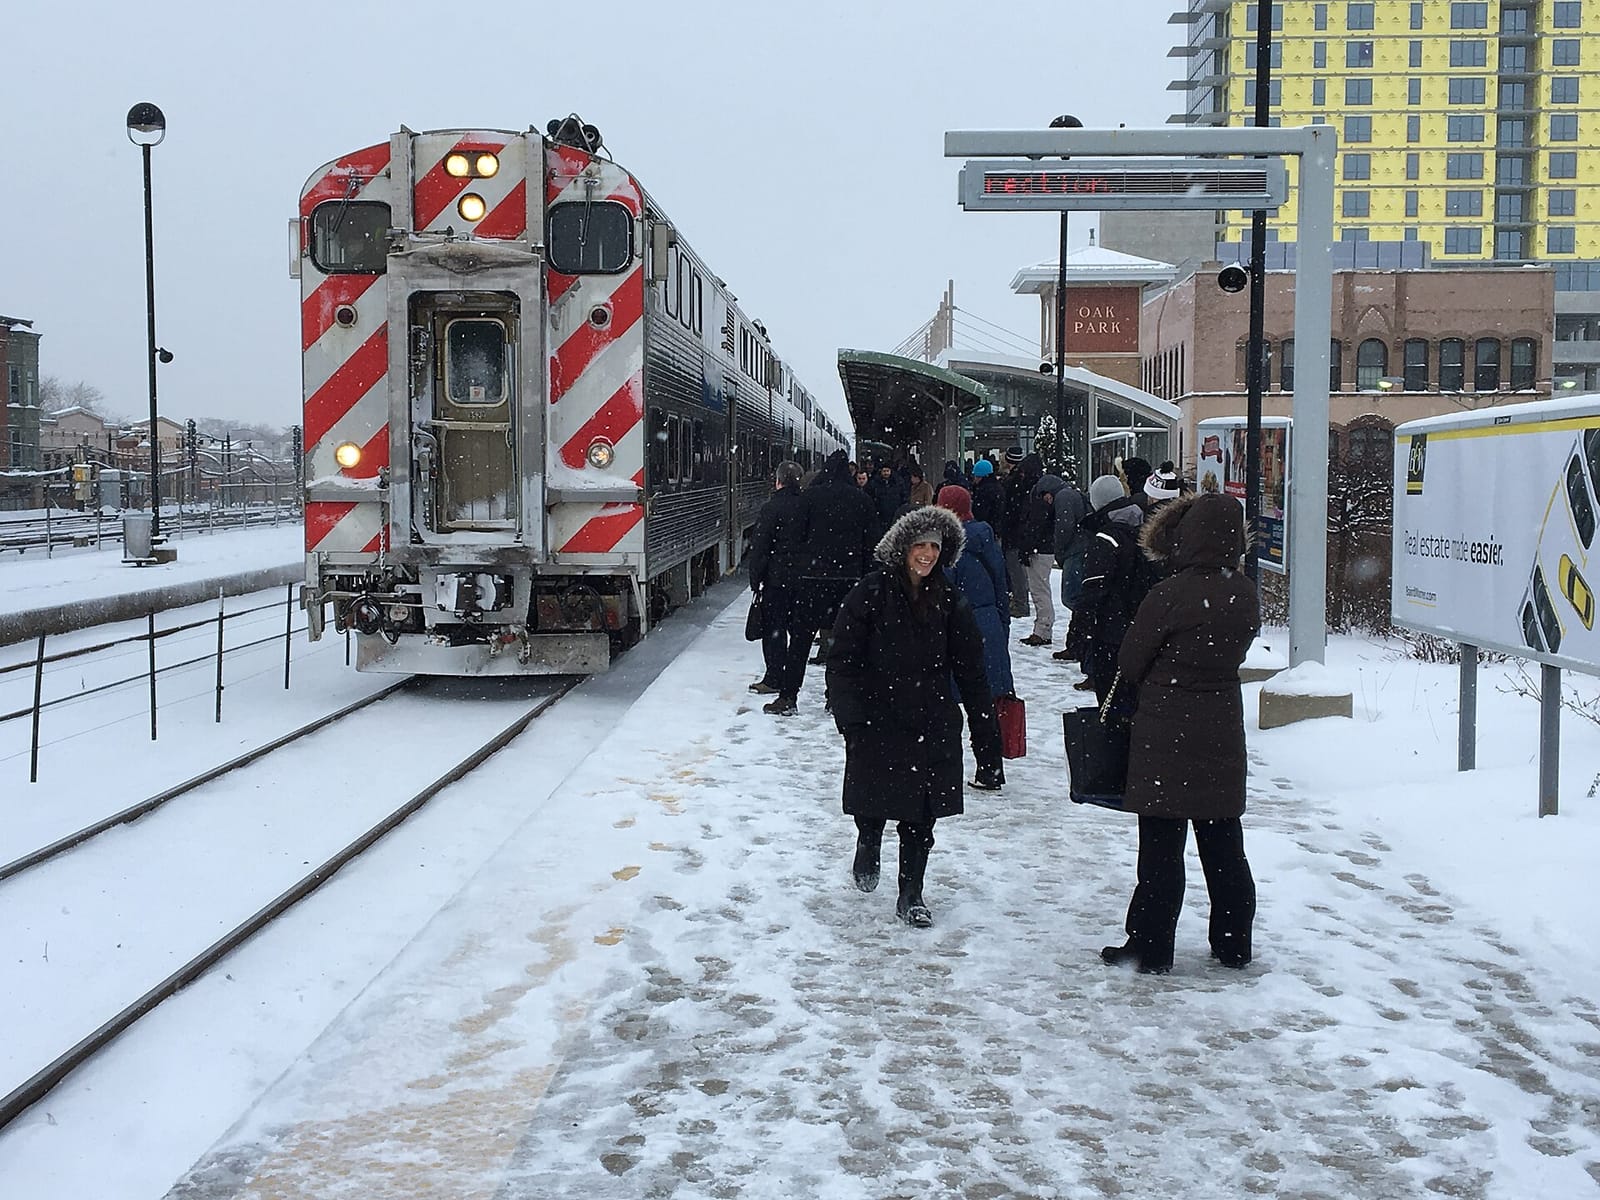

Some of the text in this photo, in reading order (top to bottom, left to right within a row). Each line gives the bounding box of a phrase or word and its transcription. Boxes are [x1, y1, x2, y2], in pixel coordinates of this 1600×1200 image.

[1079, 306, 1115, 318] OAK
[1074, 321, 1120, 334] PARK
[1420, 534, 1450, 559] estate
[1452, 533, 1469, 562] made
[1470, 534, 1504, 566] easier.
